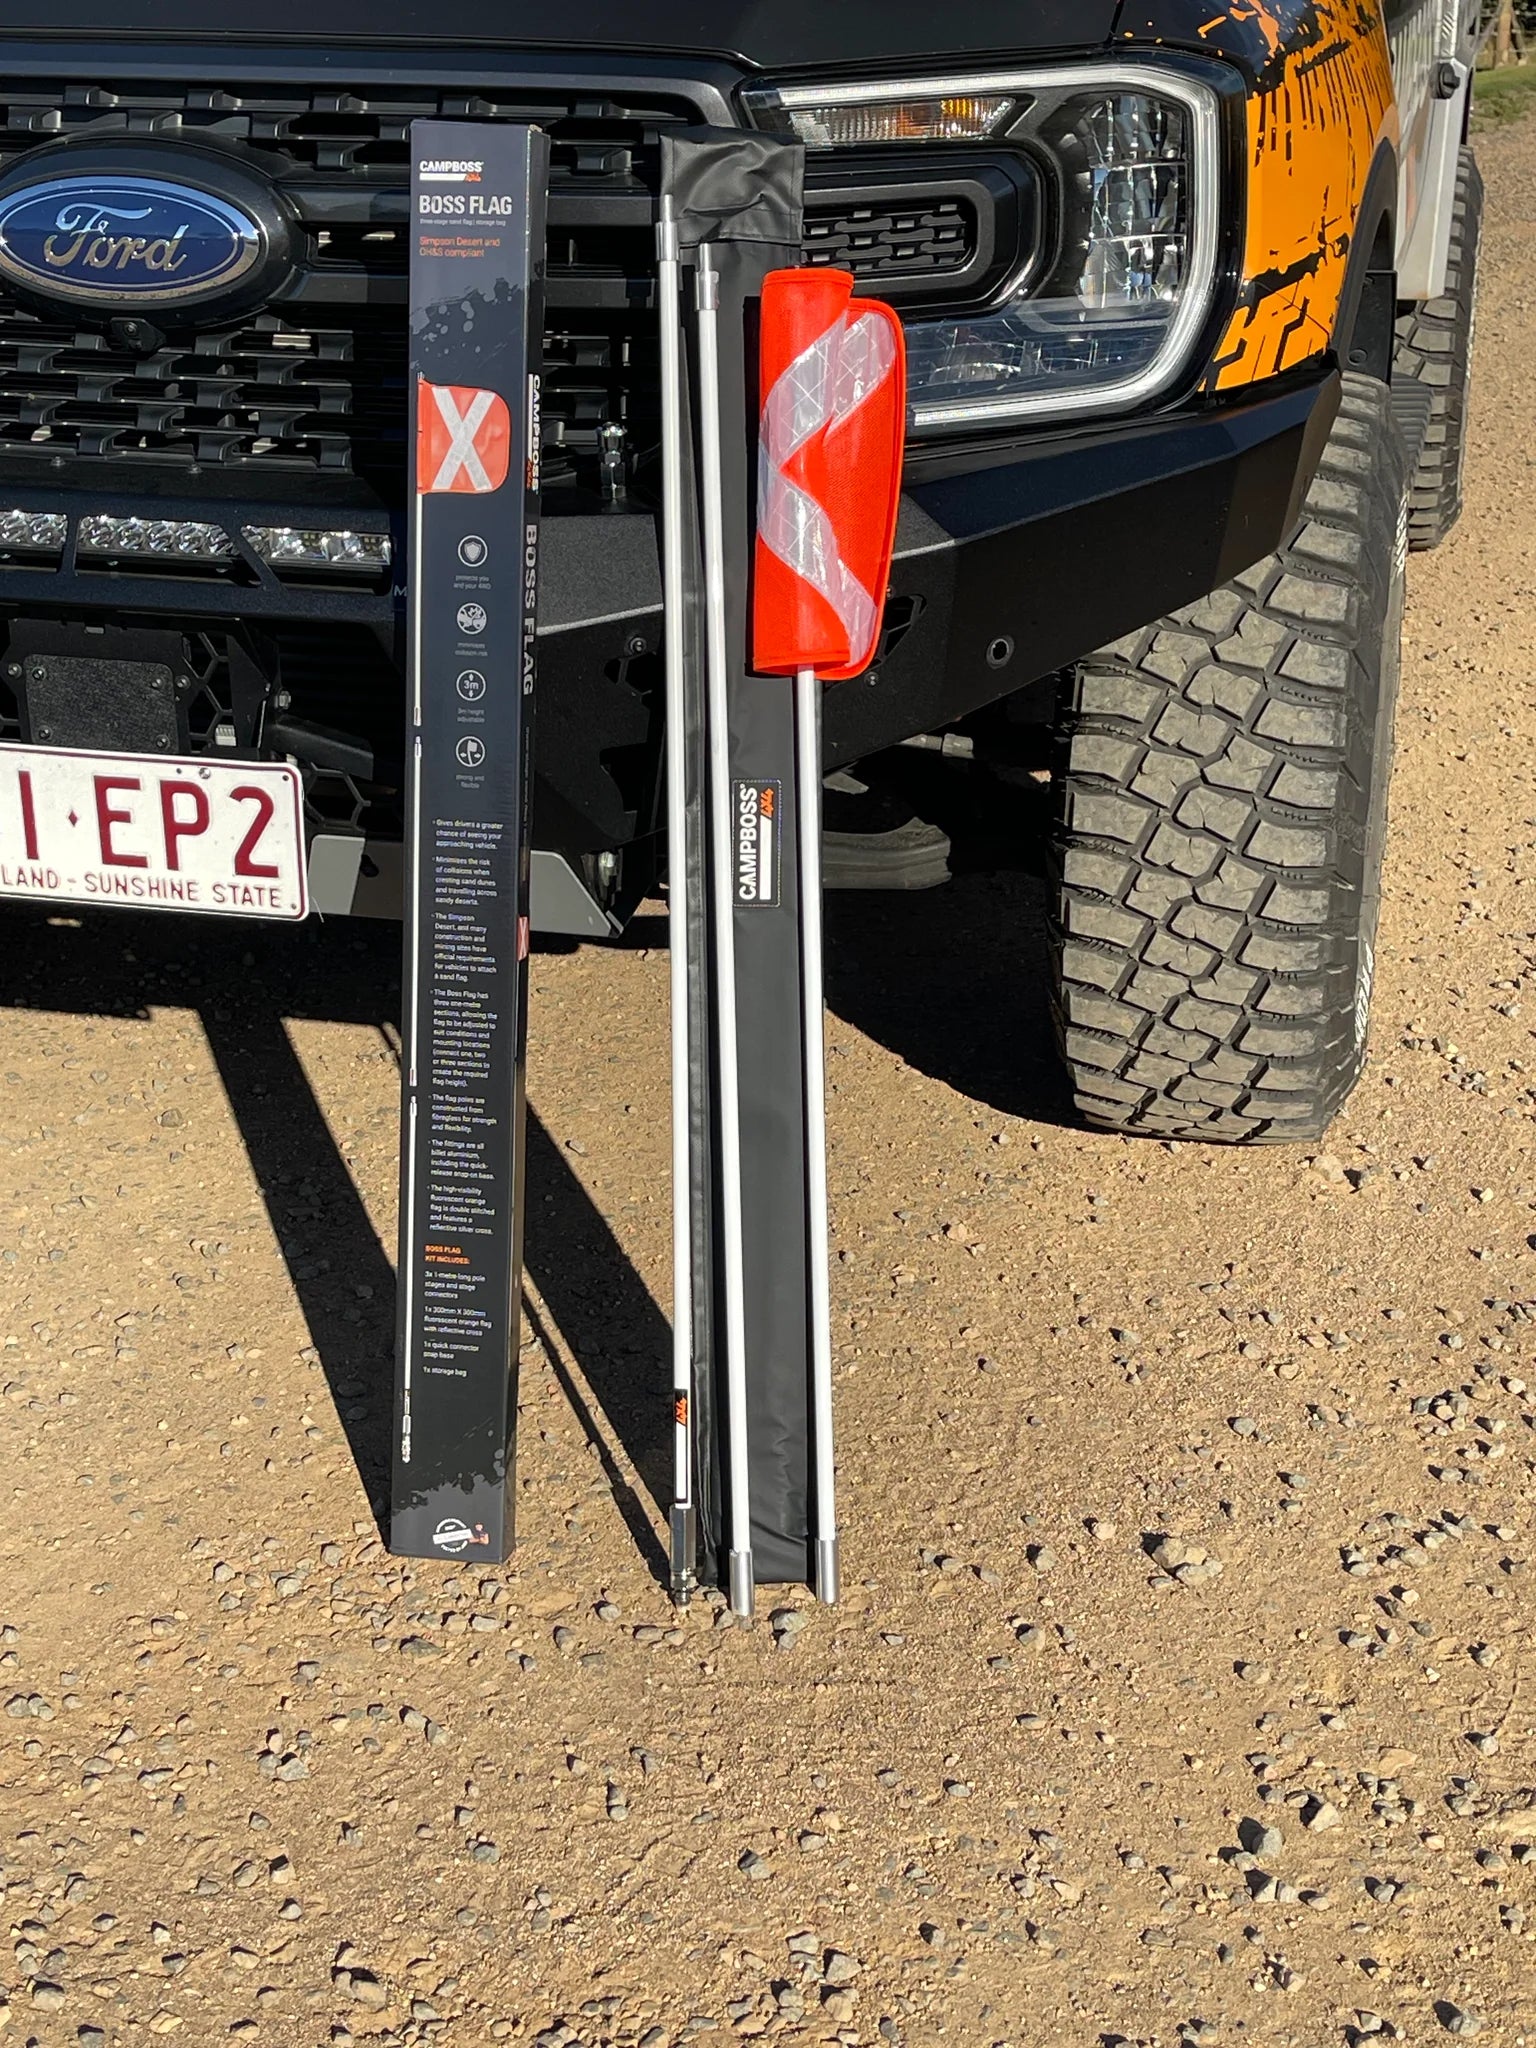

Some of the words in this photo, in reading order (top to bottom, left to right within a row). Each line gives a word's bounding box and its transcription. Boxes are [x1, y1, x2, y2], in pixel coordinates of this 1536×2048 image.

[420, 160, 482, 172] CAMPBOSS
[419, 195, 465, 214] BOSS
[469, 196, 512, 215] FLAG
[44, 202, 189, 272] Ford
[420, 236, 455, 246] Simpson
[457, 237, 483, 246] Desert
[484, 238, 500, 246] and
[444, 248, 484, 258] compliant
[532, 374, 540, 490] CAMPBOSS
[525, 524, 537, 609] BOSS
[524, 618, 535, 695] FLAG
[464, 680, 479, 690] 3m
[467, 832, 487, 840] seeing
[436, 841, 474, 850] approaching
[739, 787, 757, 900] CAMPBOSS
[85, 871, 200, 901] SUNSHINE
[213, 884, 283, 908] STATE
[436, 898, 454, 906] sandy
[448, 914, 475, 922] Simpson
[435, 934, 472, 942] construction
[434, 943, 455, 952] mining
[463, 990, 476, 999] Flag
[462, 1011, 487, 1020] allowing
[463, 1041, 490, 1049] locations
[472, 1116, 497, 1125] strength
[444, 1140, 465, 1149] fittings
[431, 1159, 459, 1169] including
[425, 1281, 445, 1290] stages
[459, 1283, 475, 1292] stage
[432, 1367, 454, 1376] storage
[455, 1368, 467, 1377] bag
